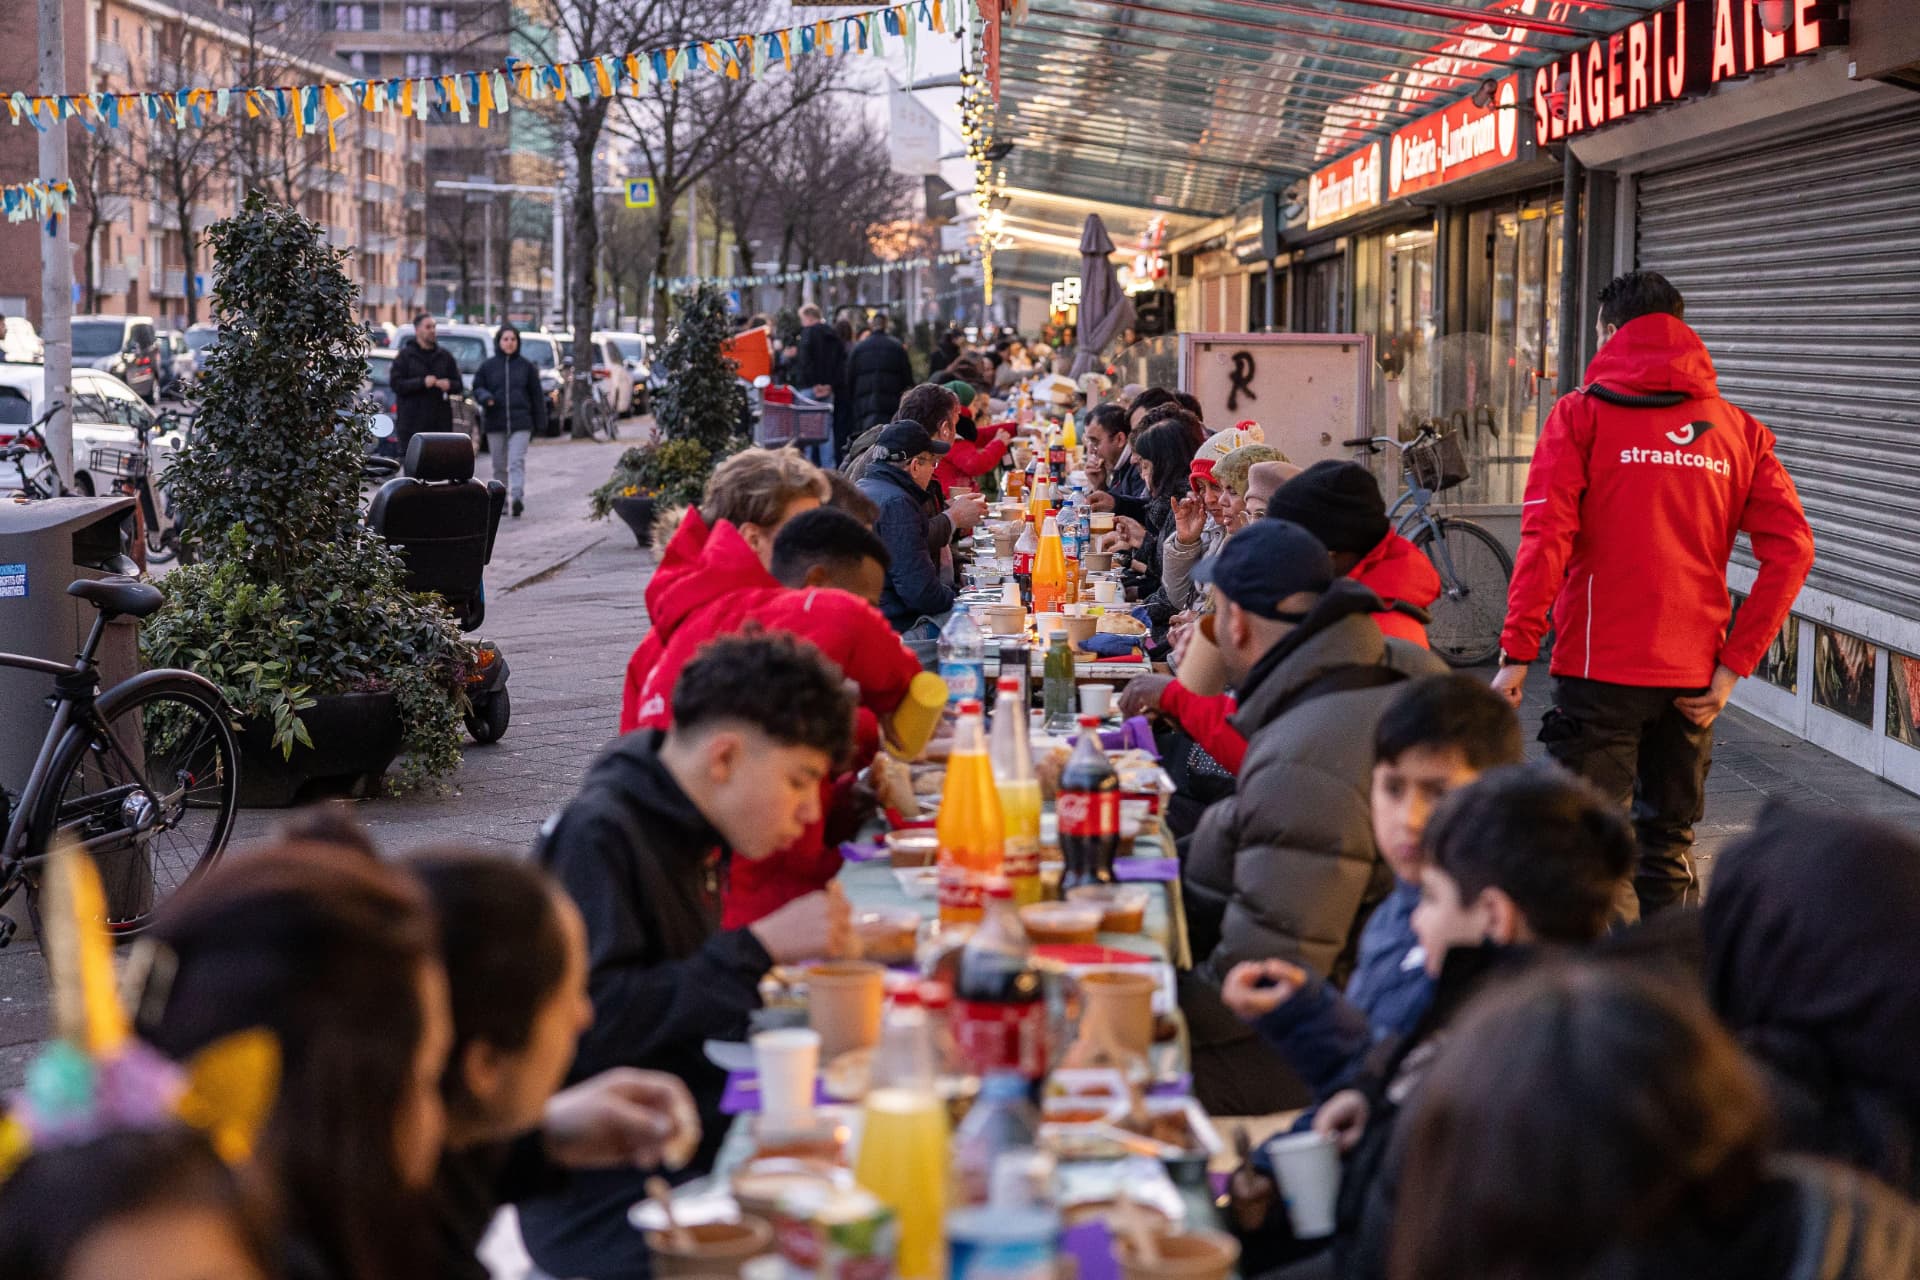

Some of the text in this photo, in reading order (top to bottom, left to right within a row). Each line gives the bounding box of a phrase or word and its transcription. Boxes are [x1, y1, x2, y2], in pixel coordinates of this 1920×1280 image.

[1534, 0, 1686, 146] SLAGERIJ
[1227, 350, 1257, 412] R
[1620, 446, 1731, 477] straatcoach
